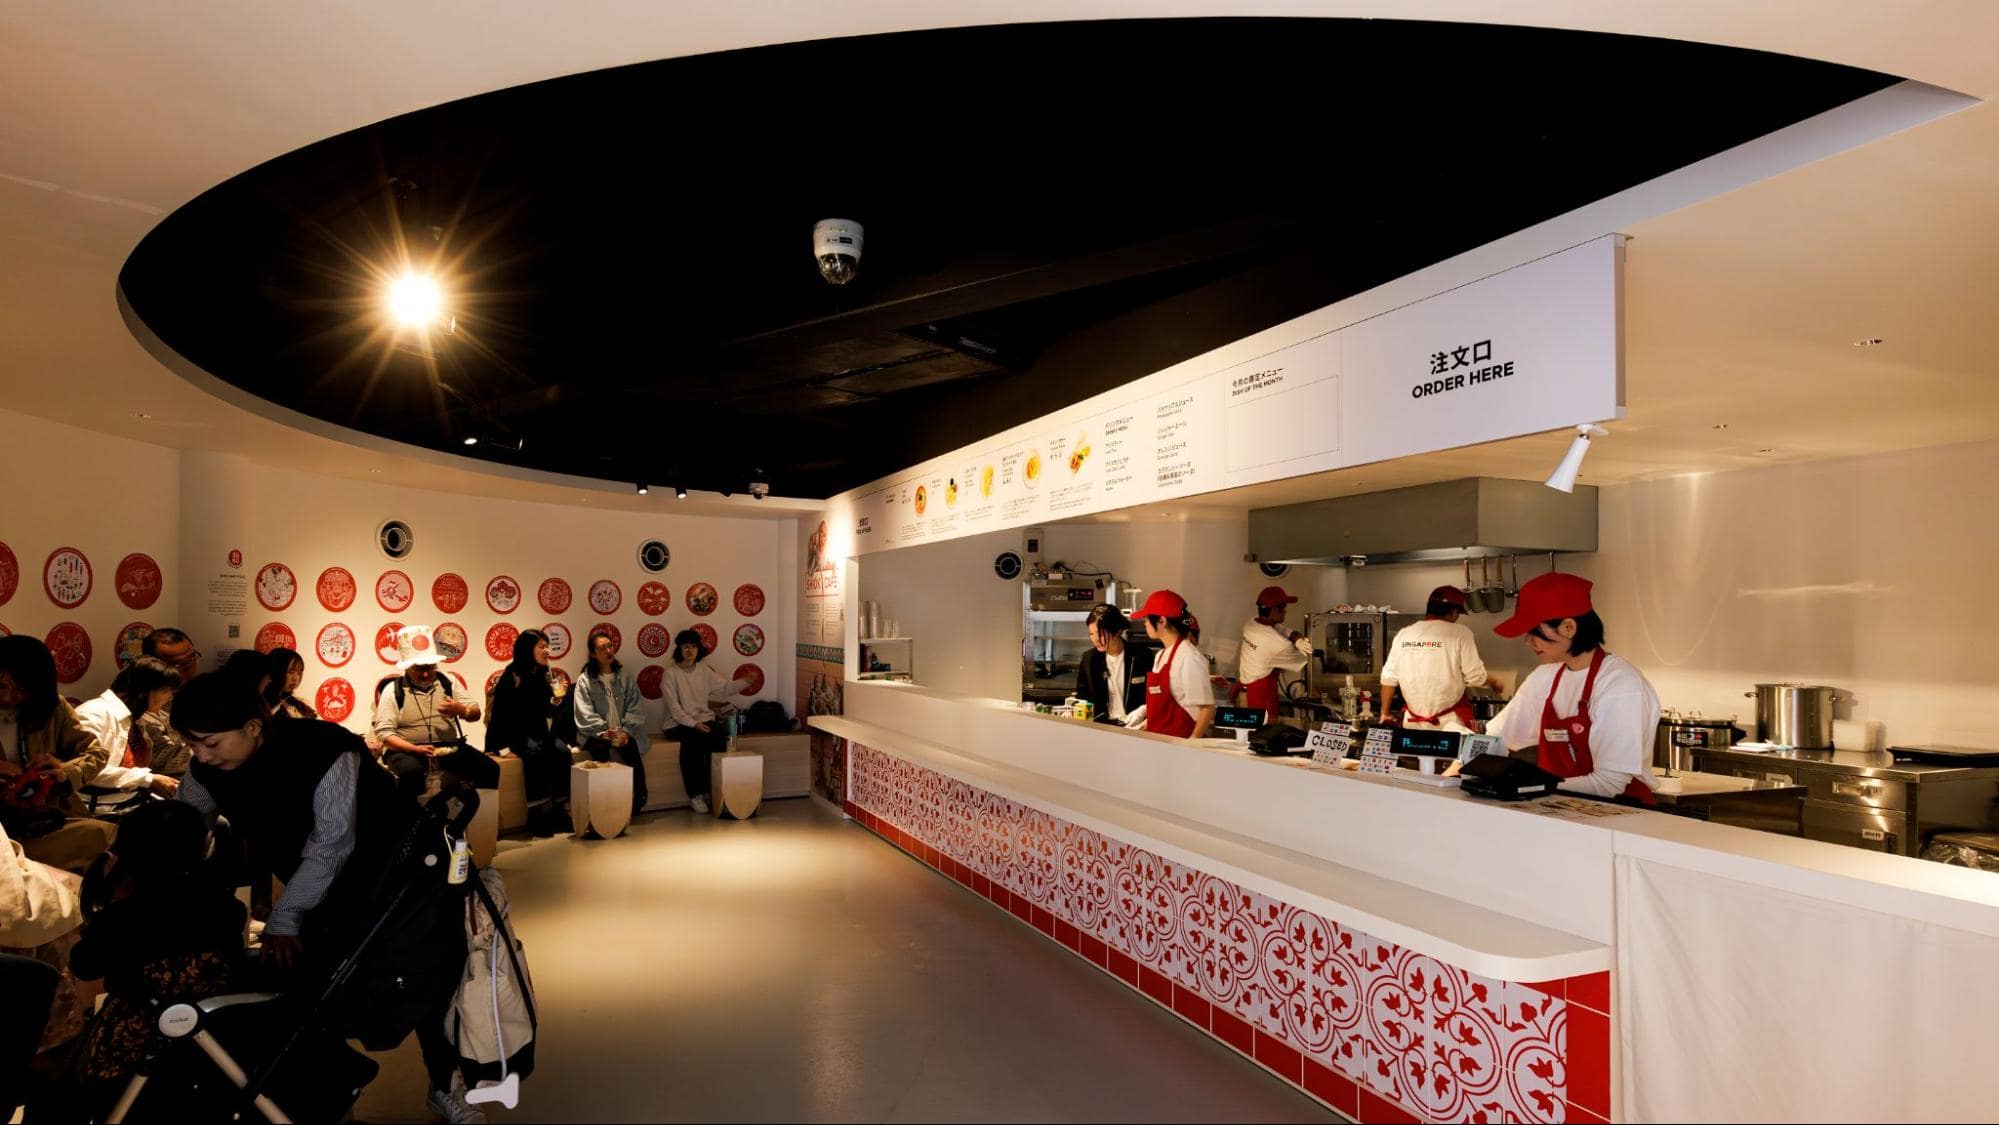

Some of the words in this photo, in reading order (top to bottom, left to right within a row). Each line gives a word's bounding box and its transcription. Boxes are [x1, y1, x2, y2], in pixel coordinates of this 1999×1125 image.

[1430, 339, 1491, 375] 注文口
[1411, 374, 1465, 399] ORDER
[1469, 361, 1514, 385] HERE
[1401, 641, 1443, 649] SINGAPORE
[1311, 734, 1348, 752] CLOSED
